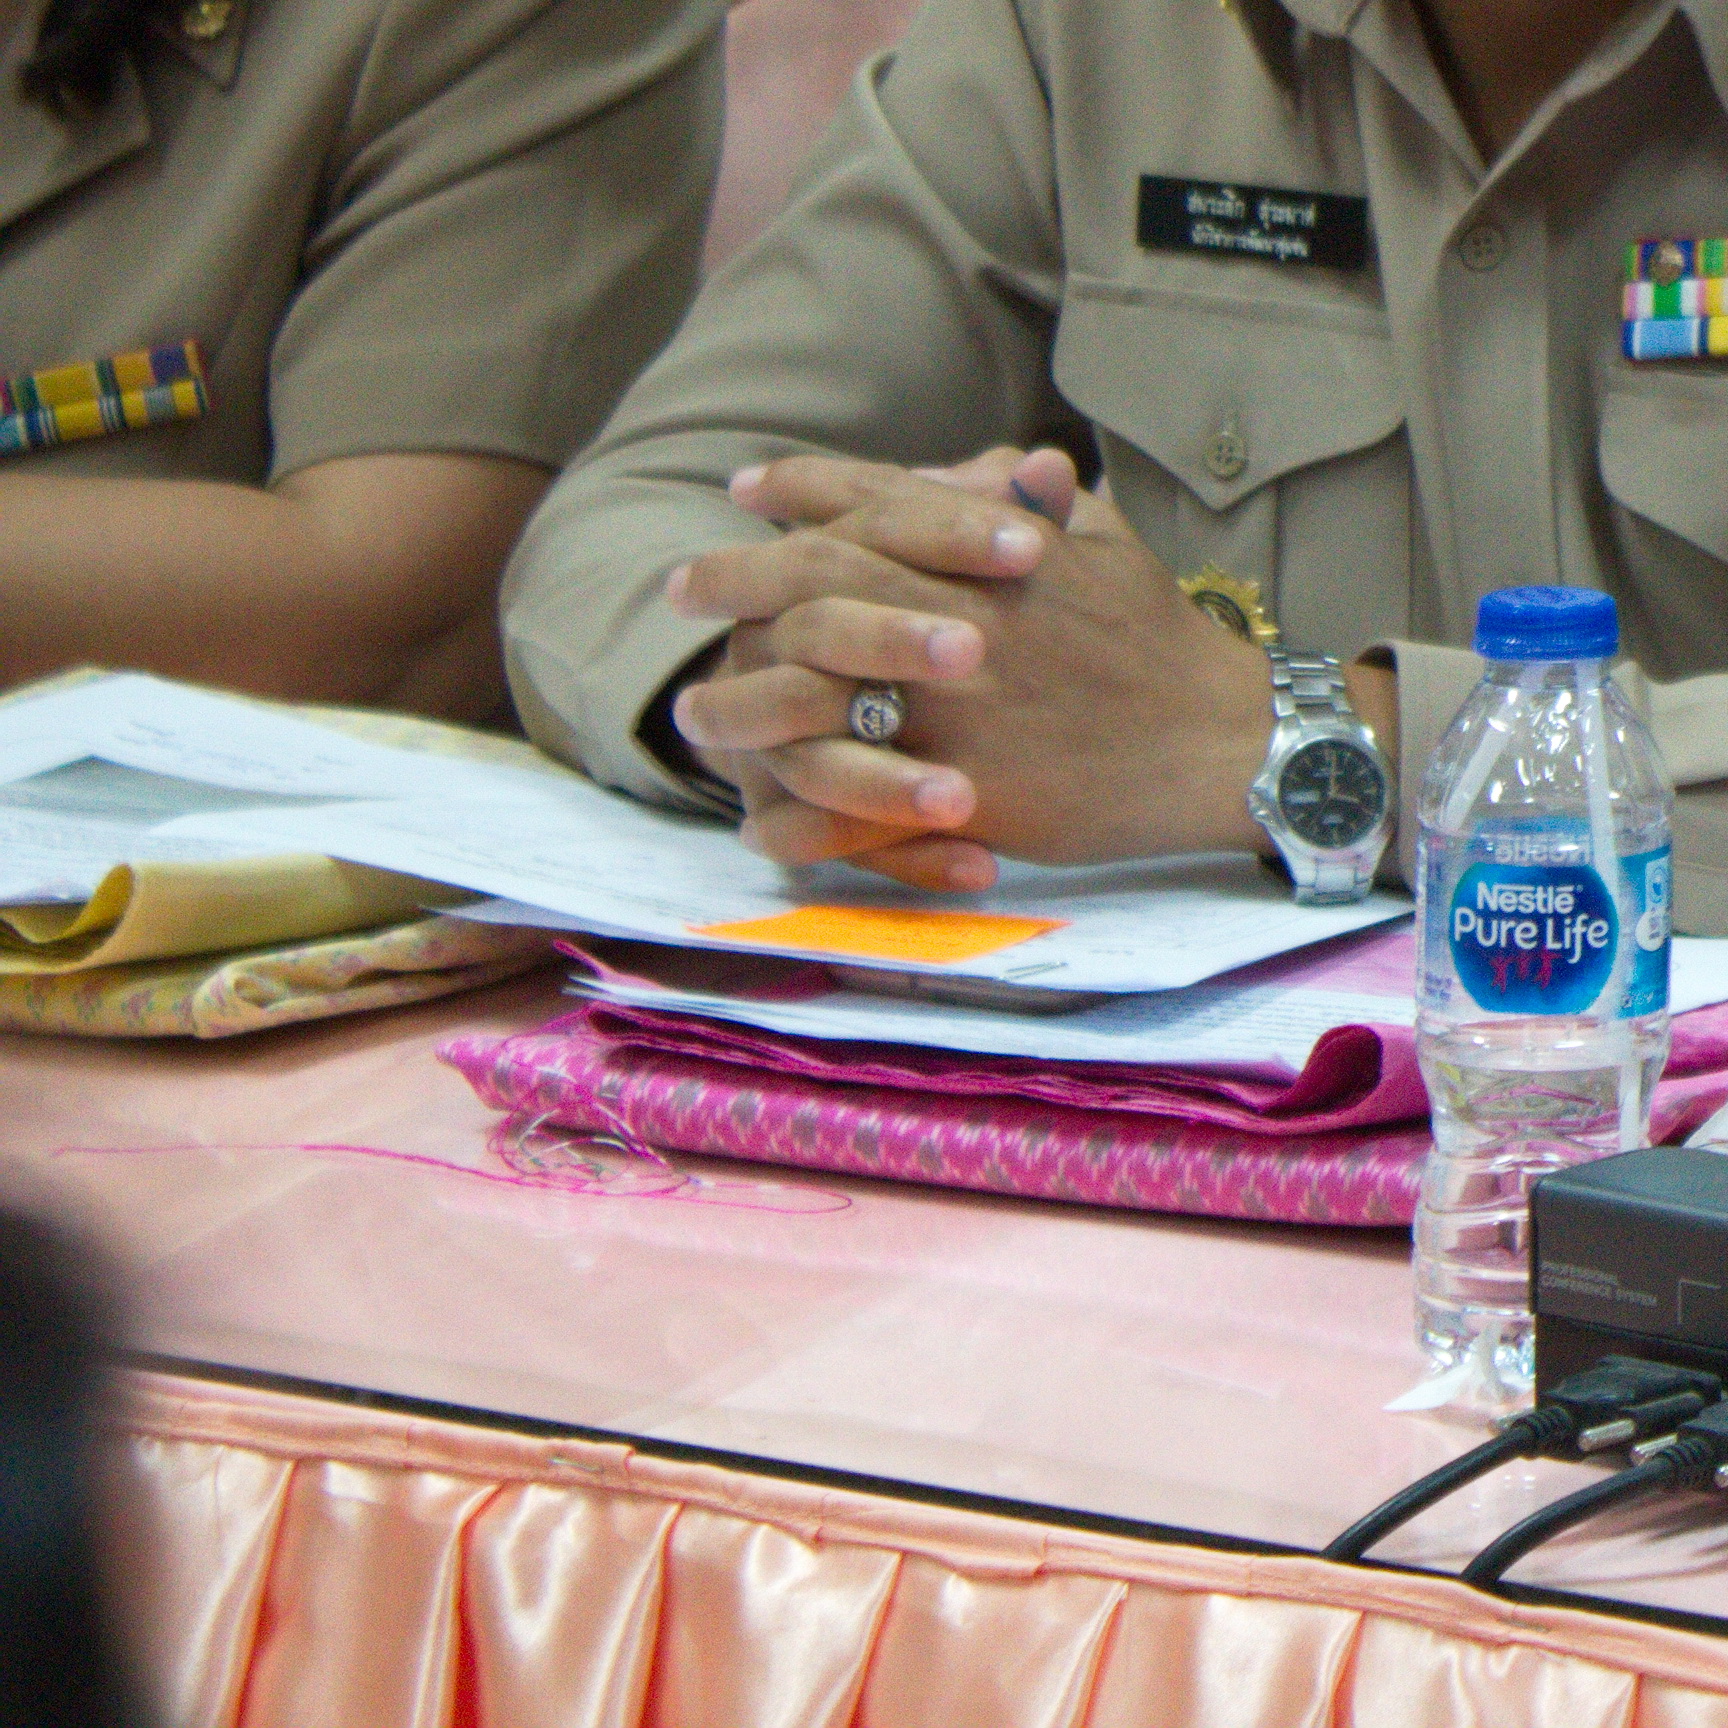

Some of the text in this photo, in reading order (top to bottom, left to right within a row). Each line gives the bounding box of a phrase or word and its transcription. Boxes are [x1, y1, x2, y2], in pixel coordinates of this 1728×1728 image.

[1454, 908, 1609, 964] Pure Life
[1540, 1275, 1658, 1307] CONFERENCE SYSTEM
